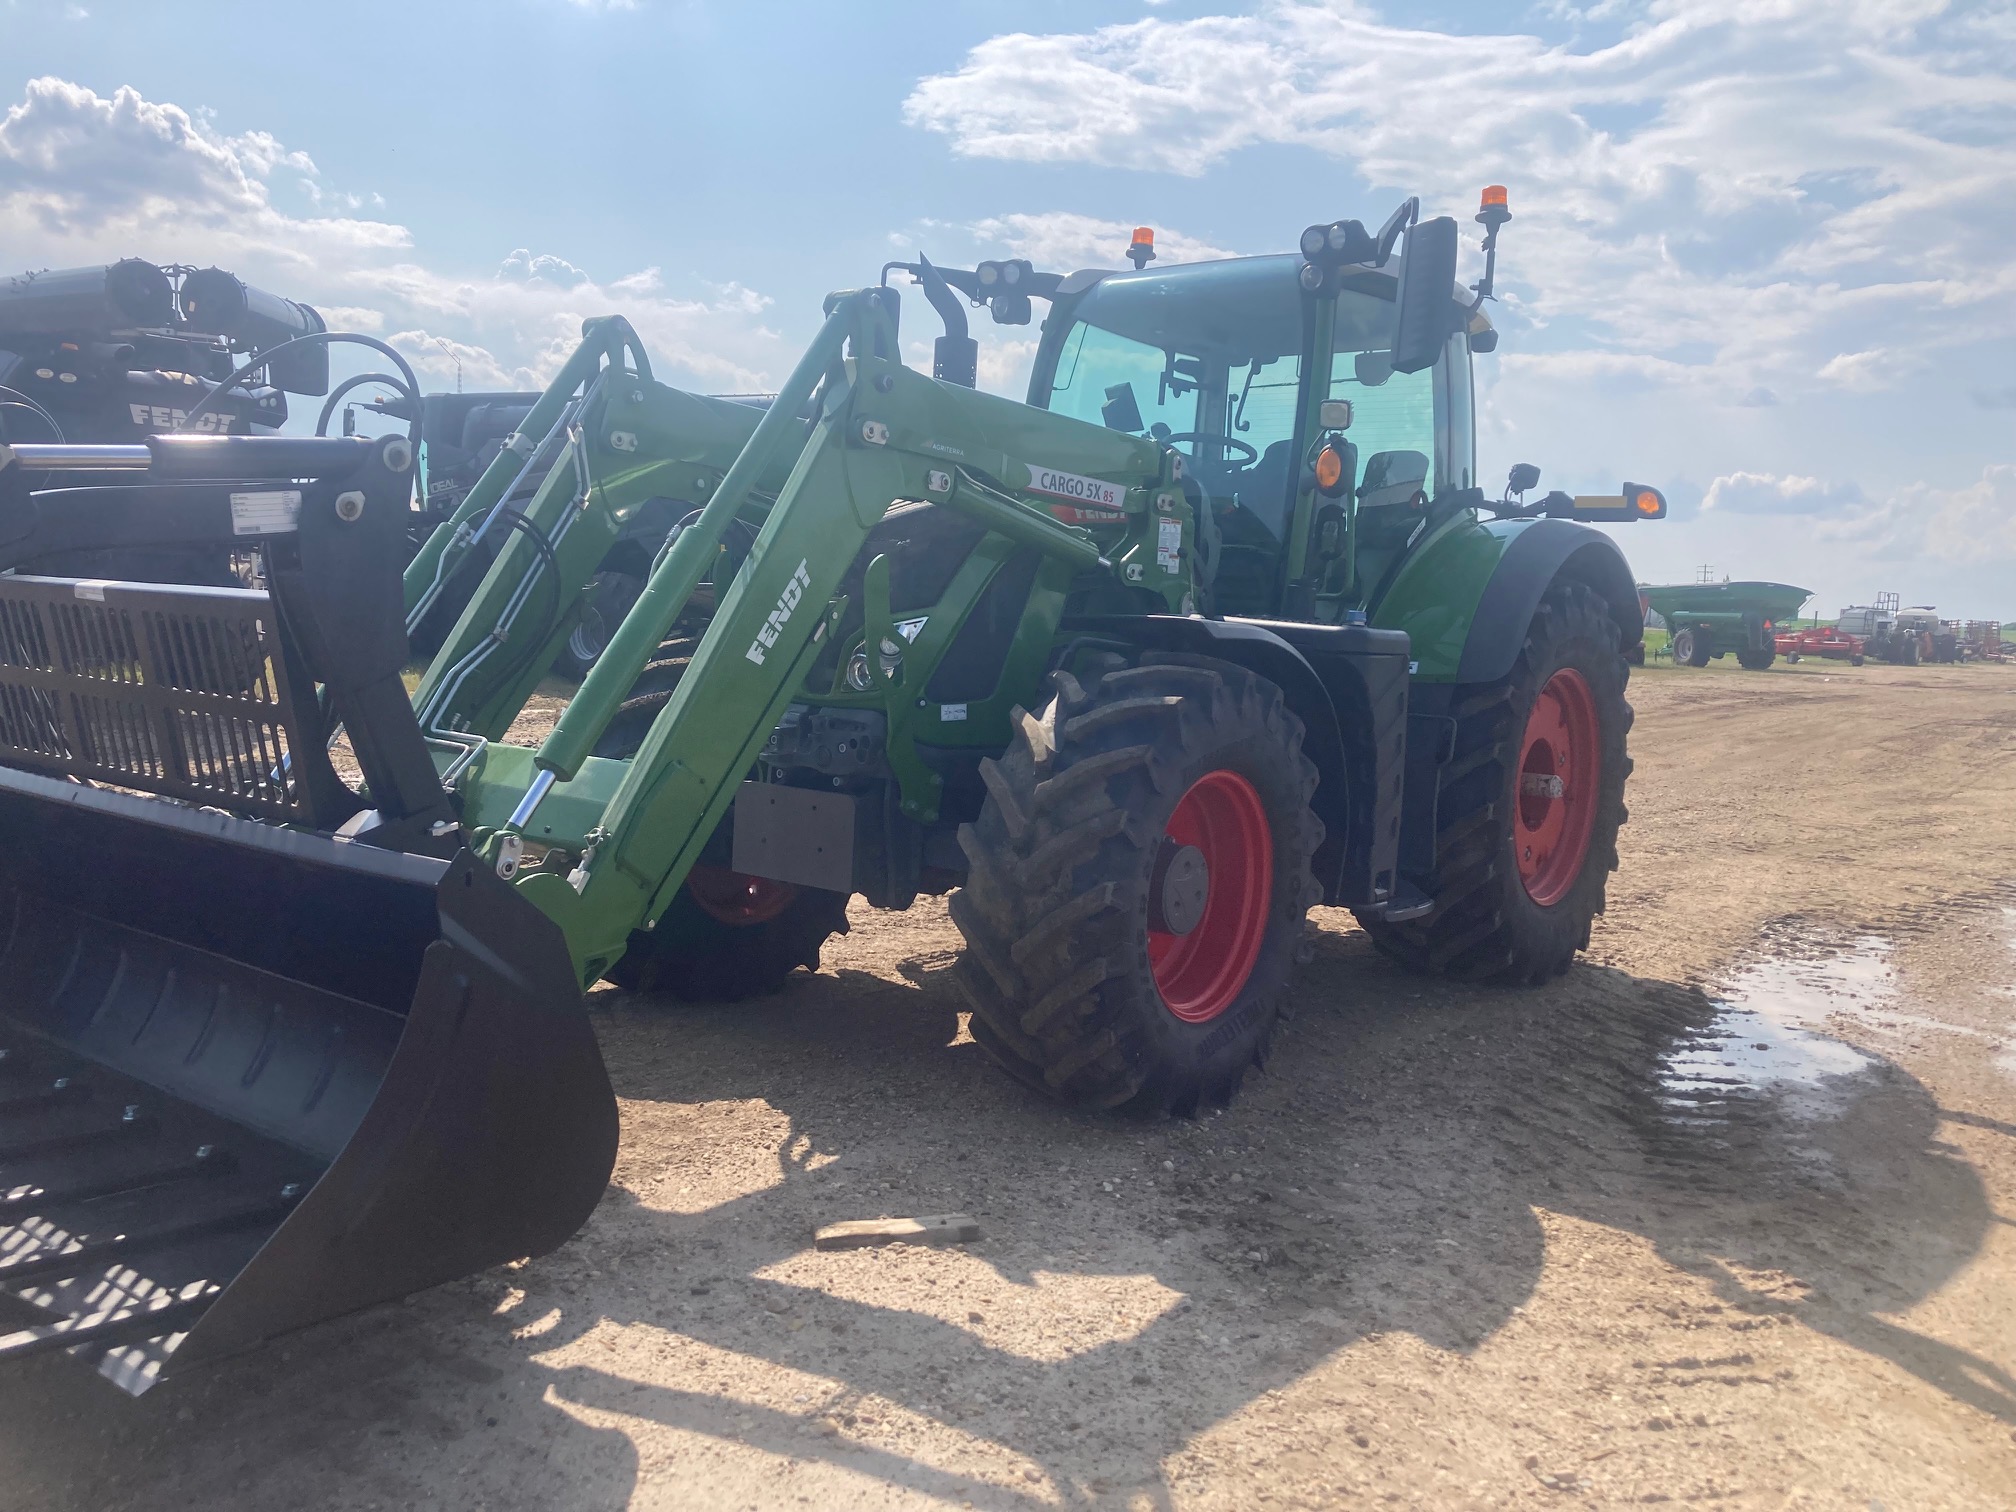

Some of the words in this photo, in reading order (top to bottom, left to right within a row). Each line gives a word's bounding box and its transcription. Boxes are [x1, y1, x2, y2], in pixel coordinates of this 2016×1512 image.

[932, 444, 964, 456] AGRITERRA
[430, 479, 458, 493] IDEAL
[1041, 472, 1084, 496] CARGO
[1086, 483, 1101, 500] 5X
[1103, 490, 1114, 503] 85
[745, 557, 811, 666] FENDT
